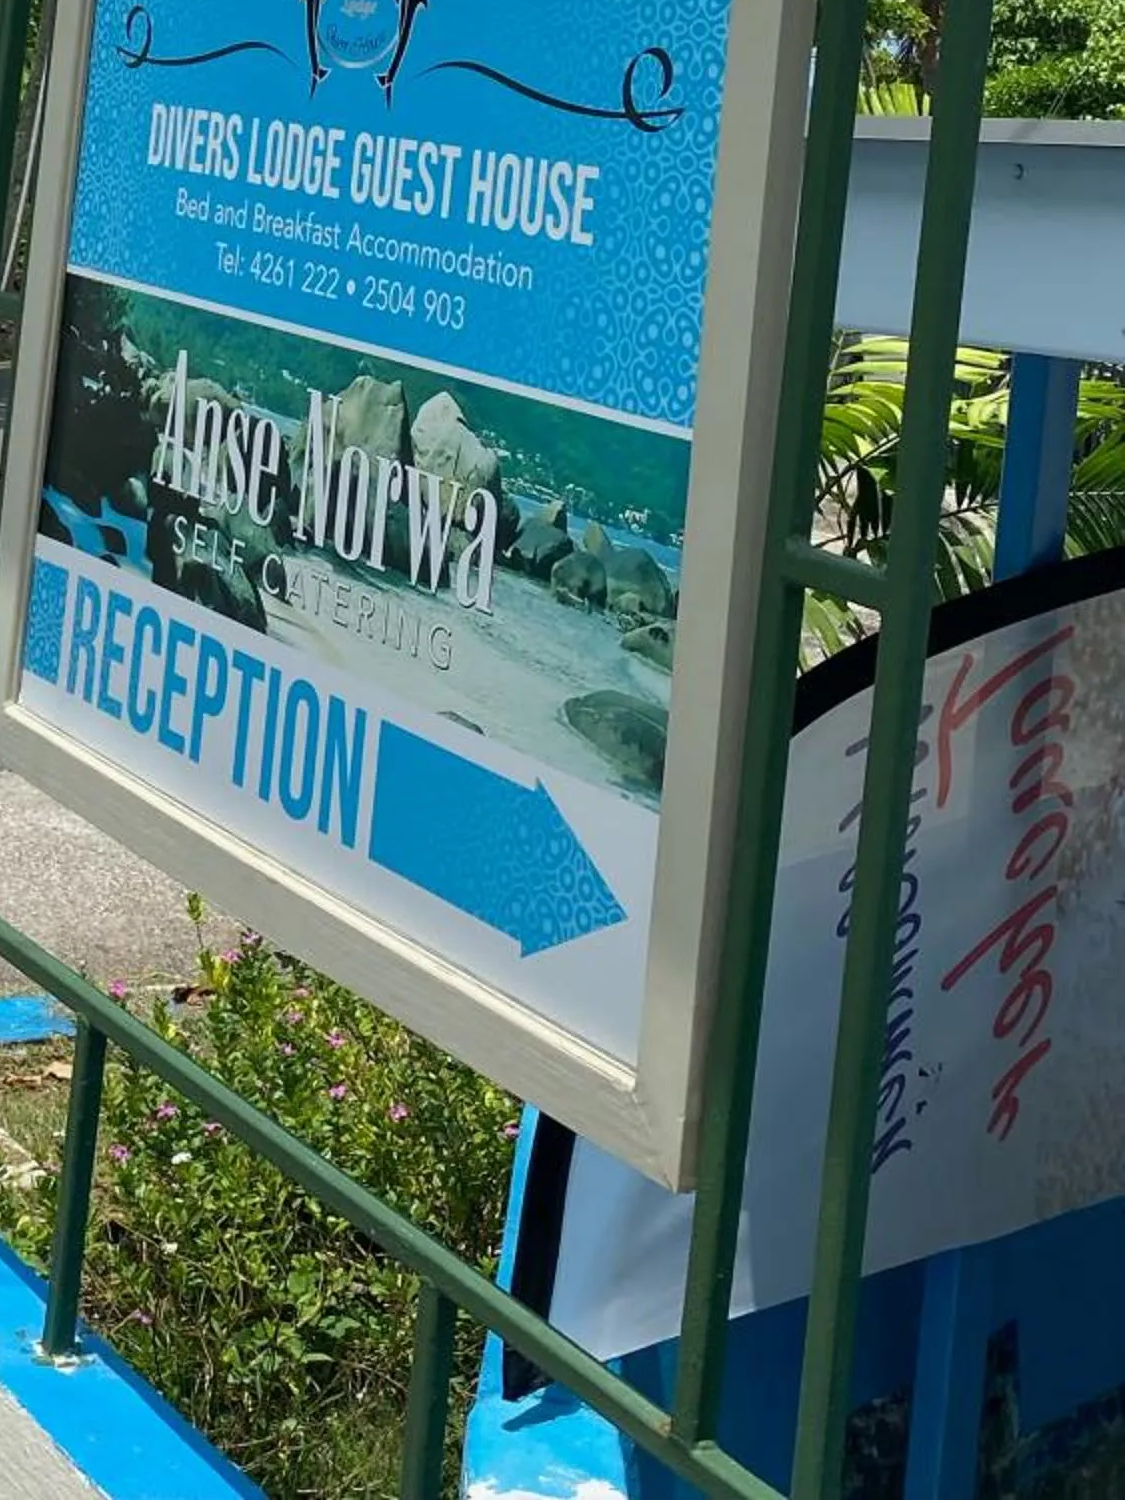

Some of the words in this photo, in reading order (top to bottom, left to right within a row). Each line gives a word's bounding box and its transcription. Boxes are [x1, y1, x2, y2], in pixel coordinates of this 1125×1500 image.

[147, 102, 244, 181] DIVERS
[246, 119, 346, 199] LODGE
[350, 135, 463, 220] GUEST
[467, 149, 601, 247] HOUSE
[175, 188, 211, 219] Bed
[214, 197, 247, 230] and
[252, 203, 342, 252] Breakfast
[346, 225, 535, 292] Accommodation
[215, 242, 246, 276] Tel:
[250, 252, 296, 289] 4261
[300, 260, 340, 300] 222
[362, 275, 418, 318] 2504
[423, 287, 467, 331] 903
[152, 349, 280, 528] Anse
[293, 389, 499, 617] Norwa
[172, 514, 248, 576] SELF
[261, 552, 454, 672] CATERING
[66, 578, 368, 849] RECEPTION
